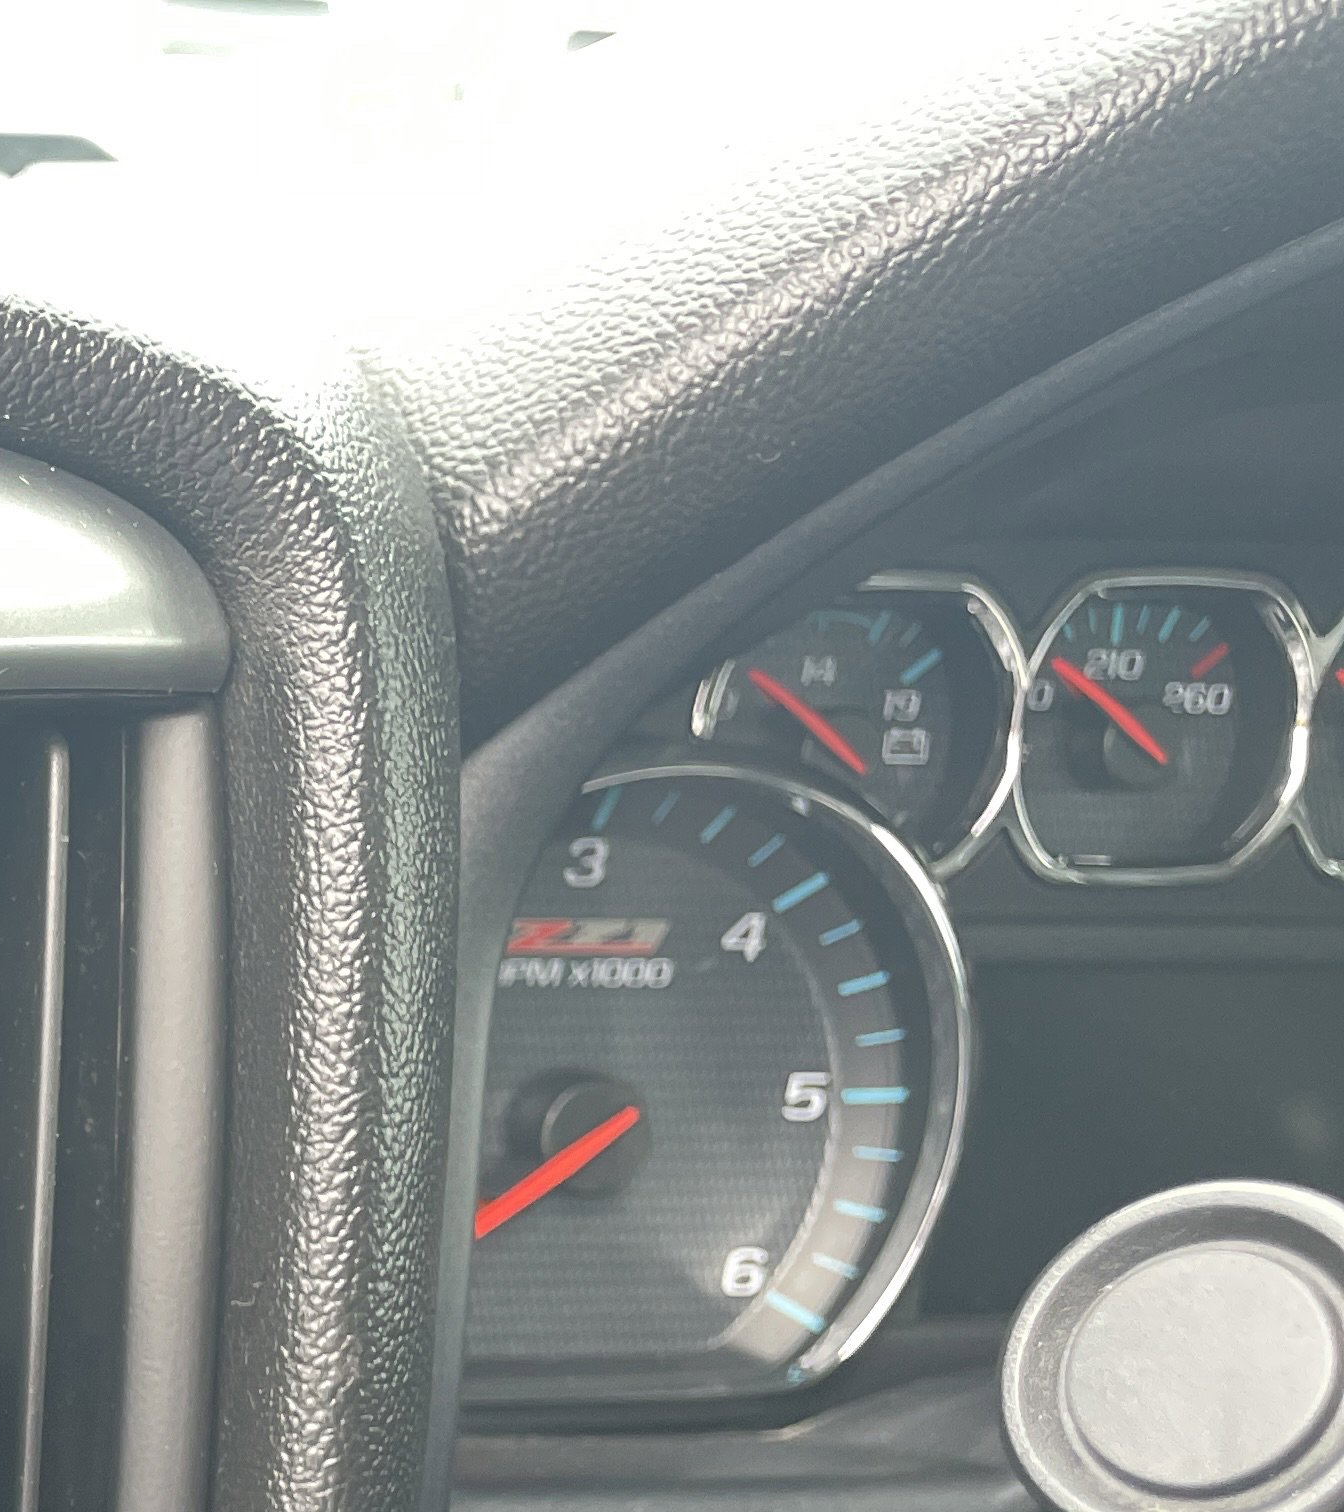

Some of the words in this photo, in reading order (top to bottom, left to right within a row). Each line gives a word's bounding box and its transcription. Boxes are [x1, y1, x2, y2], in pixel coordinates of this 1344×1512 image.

[1083, 649, 1144, 680] 210
[563, 836, 610, 889] 3
[720, 911, 767, 963] 4
[498, 957, 565, 989] PM
[781, 1071, 832, 1122] 5
[721, 1245, 769, 1298] 6
